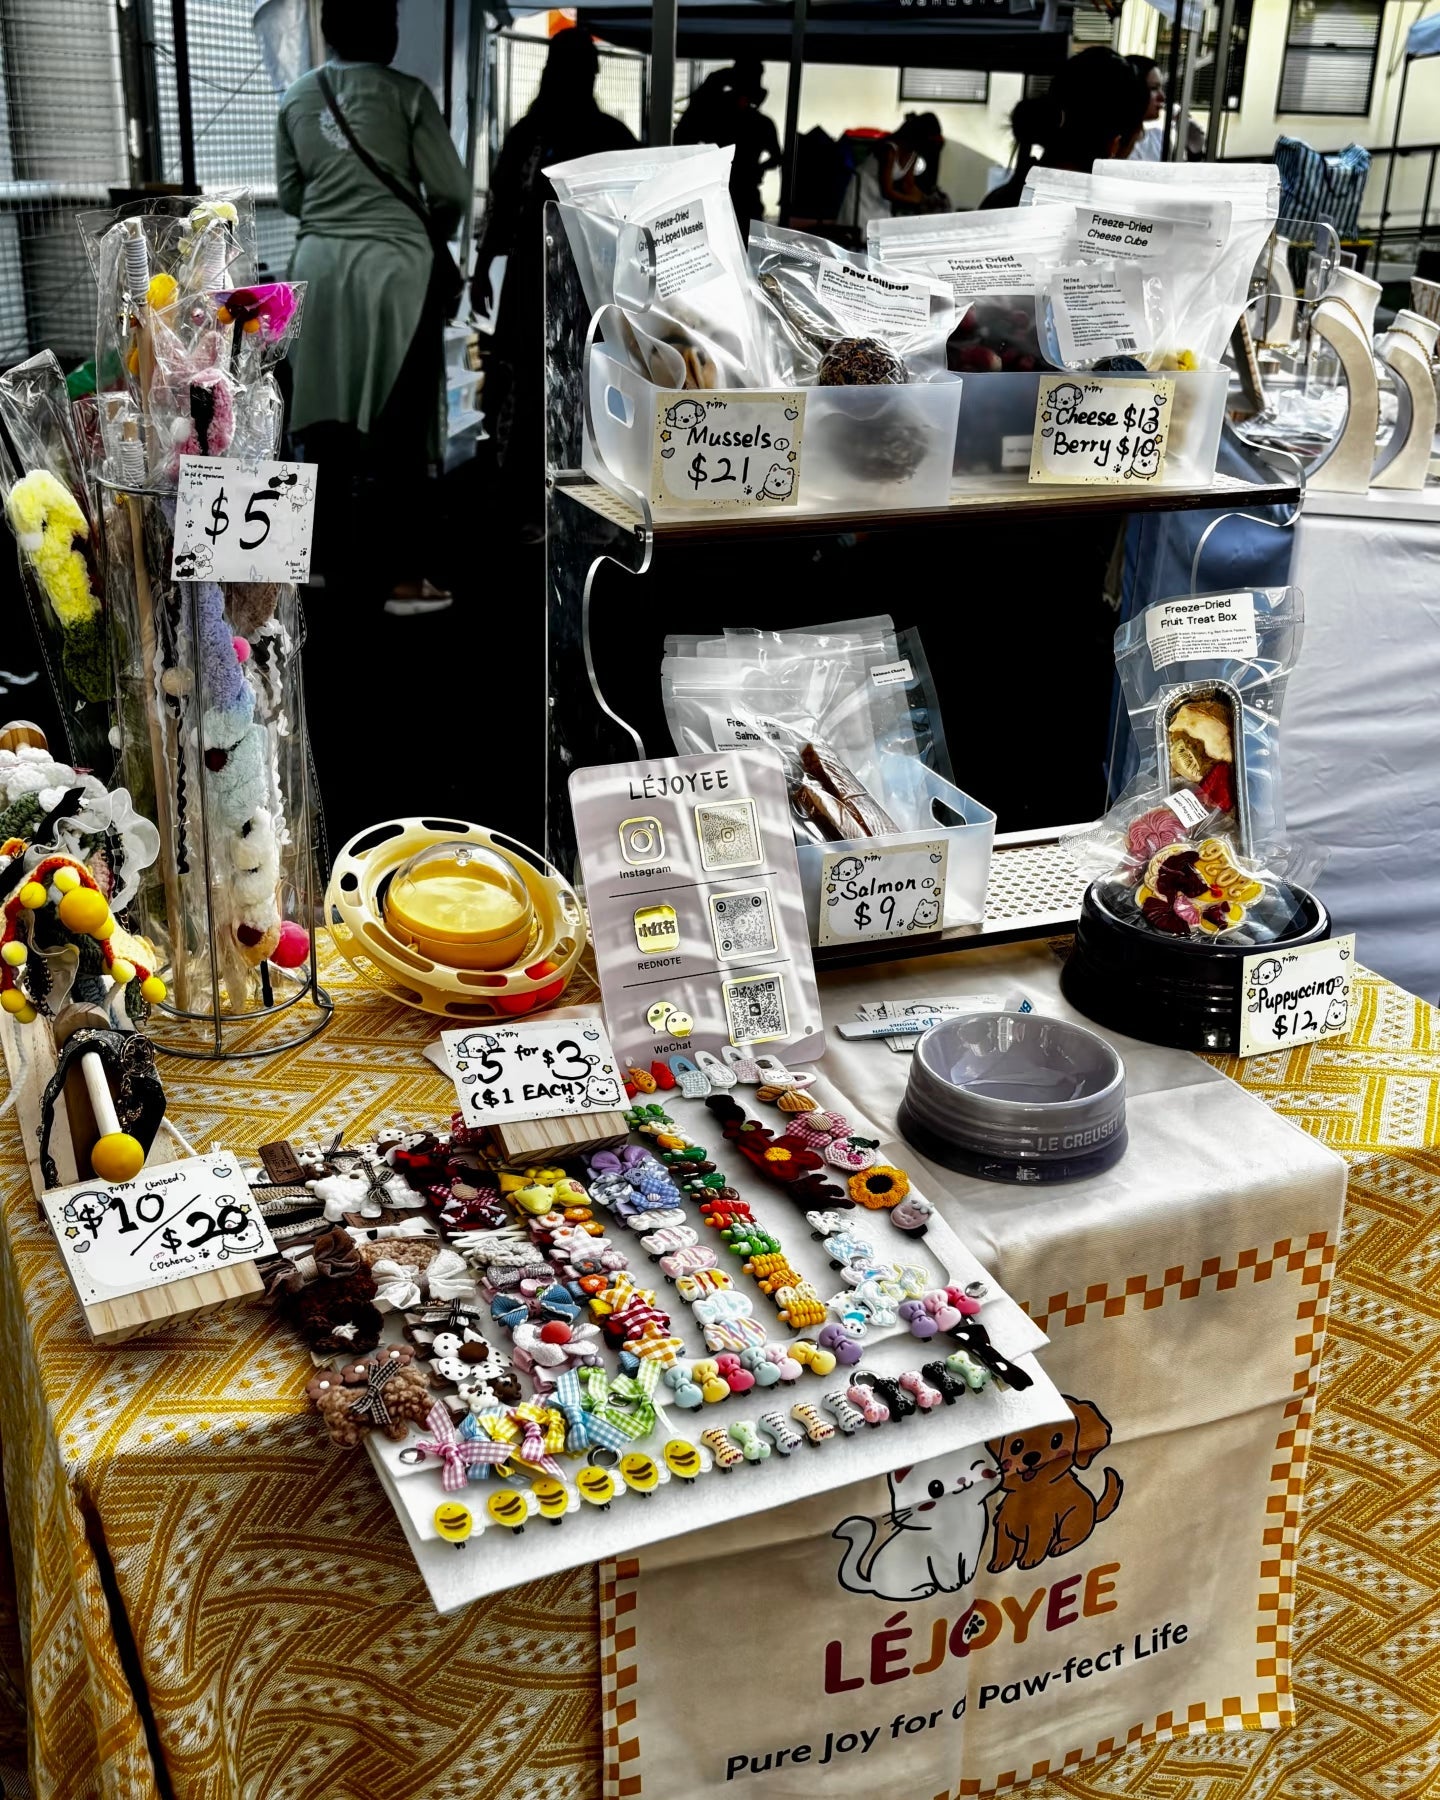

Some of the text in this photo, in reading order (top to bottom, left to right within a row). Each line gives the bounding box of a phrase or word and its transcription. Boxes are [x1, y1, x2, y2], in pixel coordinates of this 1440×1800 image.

[654, 209, 690, 231] Freeze-Dried
[680, 221, 704, 238] Mussels
[1091, 214, 1153, 234] Freeze-Dried
[1087, 228, 1148, 247] Cheese Cube
[985, 262, 1023, 270] Berries
[842, 266, 910, 291] Paw Lollipop
[1056, 403, 1160, 434] Cheese $13
[686, 424, 772, 449] Mussels
[1053, 431, 1156, 467] Berry $10
[687, 452, 750, 491] $21
[204, 487, 281, 550] $5
[1164, 598, 1231, 615] Freeze-Dried
[1160, 612, 1237, 629] Fruit Treat Box
[629, 768, 729, 801] LÉJOYEE
[619, 864, 672, 880] Instagram
[840, 877, 917, 901] Salmon
[853, 895, 896, 931] $9
[637, 956, 682, 971] REDNOTE
[1258, 977, 1335, 1015] Puppyccino
[1272, 1010, 1318, 1040] $12
[653, 1041, 692, 1055] WeChat
[476, 1047, 506, 1084] 5
[514, 1044, 539, 1061] for
[522, 1081, 586, 1101] EACH)
[1037, 1137, 1059, 1152] LE
[823, 1561, 1122, 1695] LÉJOYEE
[725, 1743, 812, 1781] Pure
[819, 1726, 881, 1765] Joy
[889, 1710, 944, 1739] for
[978, 1643, 1126, 1710] Paw-fect
[1133, 1621, 1189, 1660] Life
